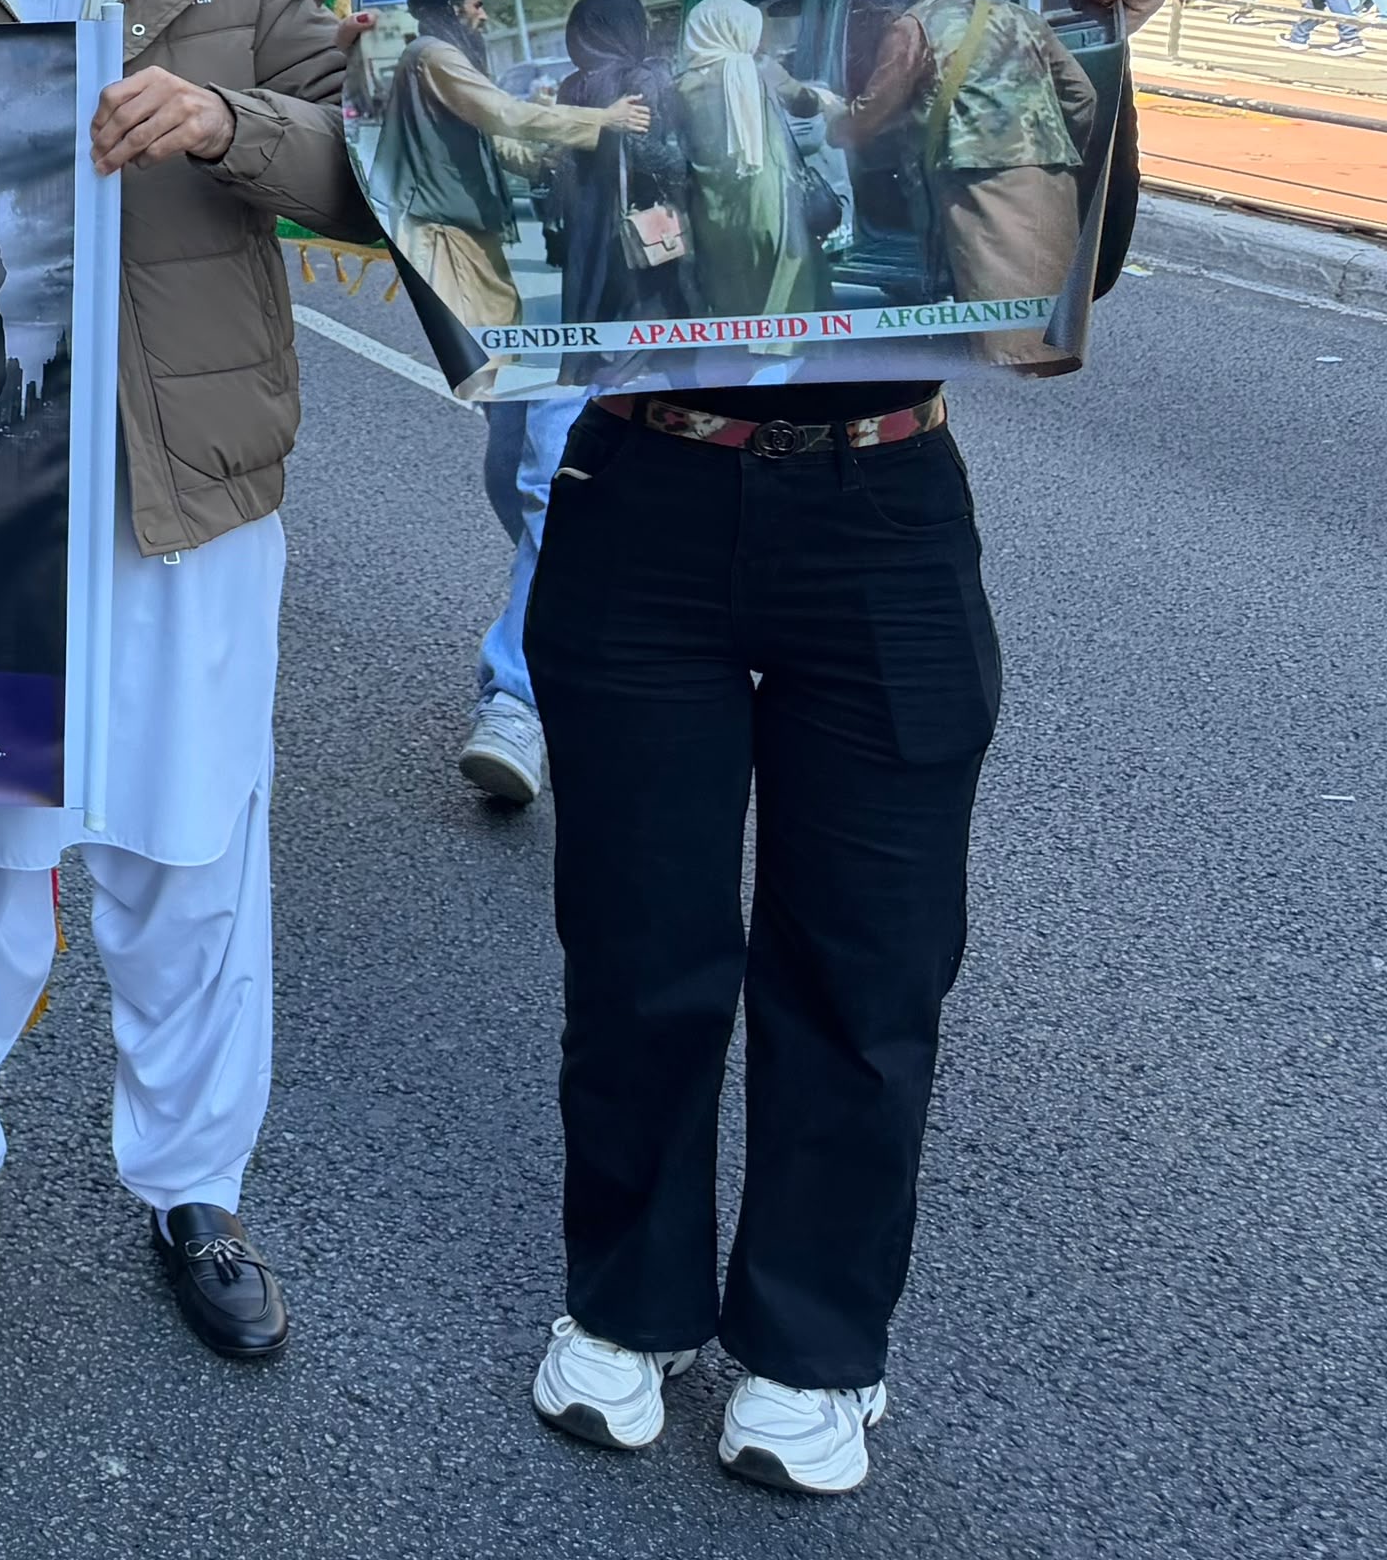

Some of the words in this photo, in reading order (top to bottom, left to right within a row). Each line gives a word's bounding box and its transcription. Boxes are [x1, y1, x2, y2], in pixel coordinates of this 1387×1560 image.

[481, 326, 602, 350] GENDER
[627, 316, 809, 345] APARTHEID
[819, 314, 853, 336] IN
